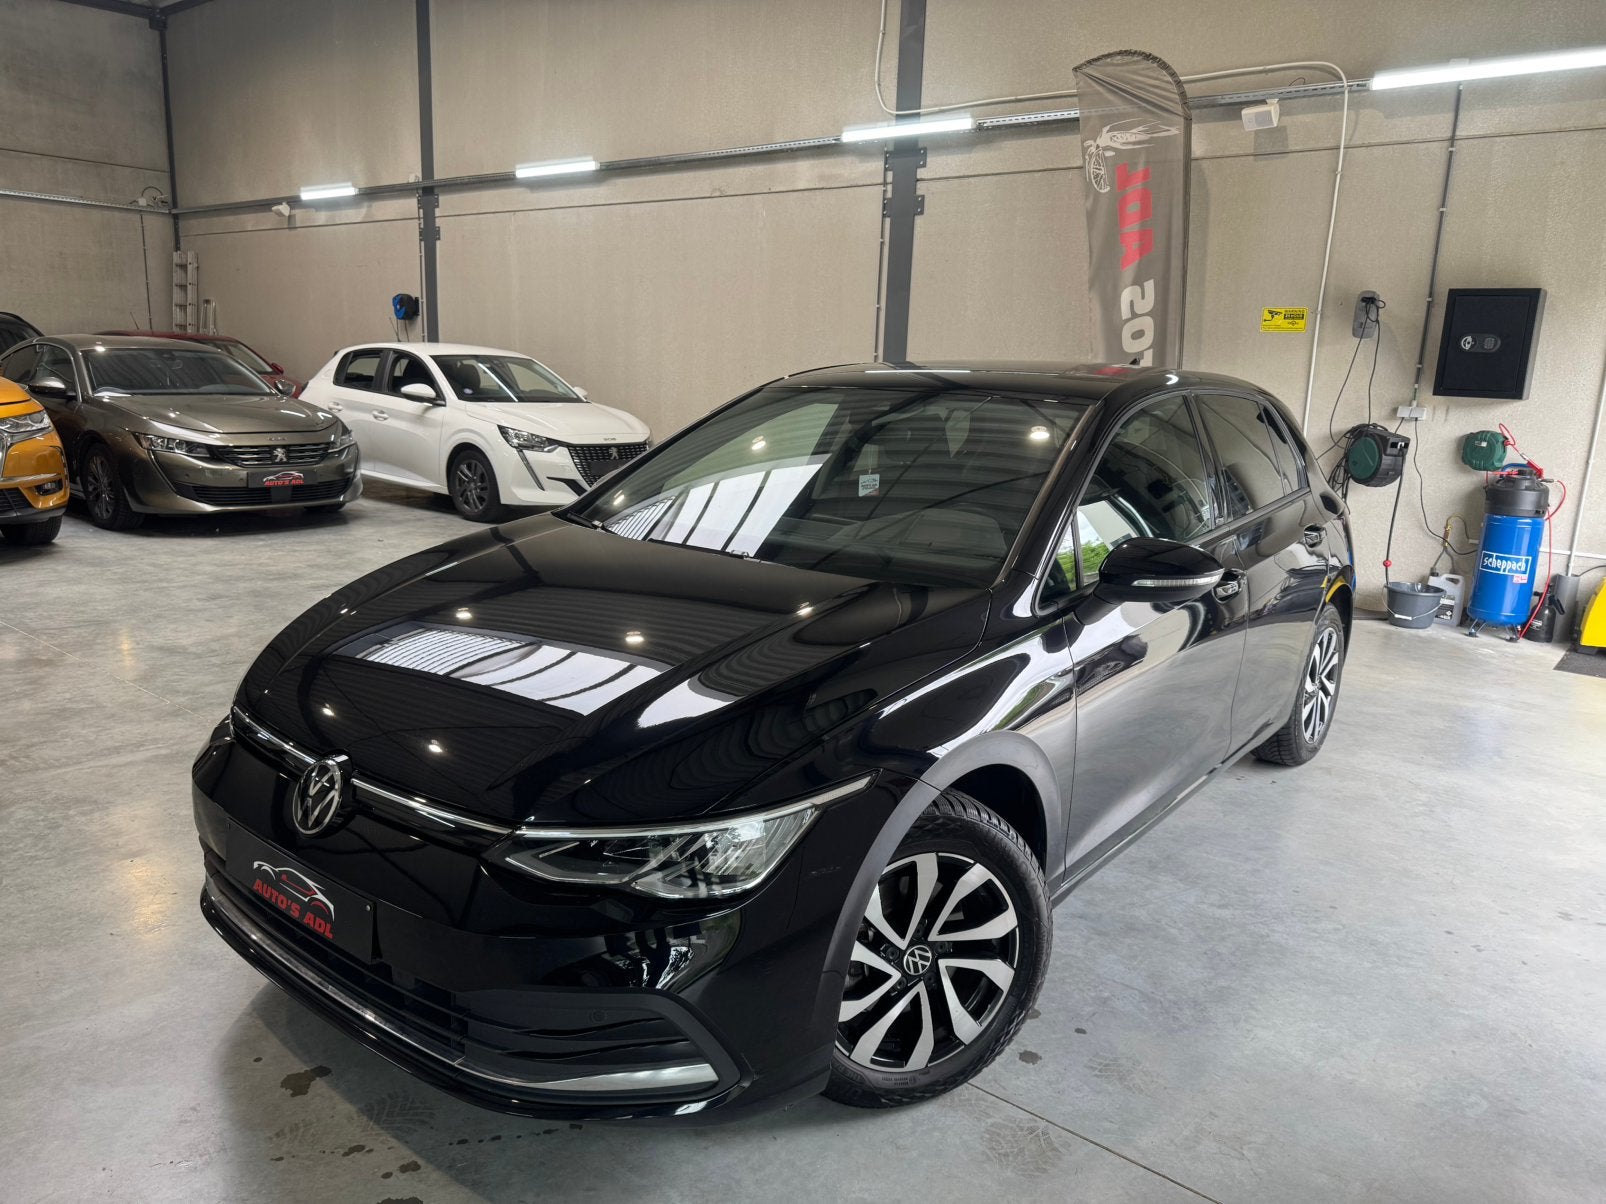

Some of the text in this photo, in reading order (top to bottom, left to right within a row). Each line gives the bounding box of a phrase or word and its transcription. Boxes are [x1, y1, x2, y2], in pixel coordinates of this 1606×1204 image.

[1483, 554, 1527, 573] scheppach
[253, 878, 334, 940] AUTO'S ADL
